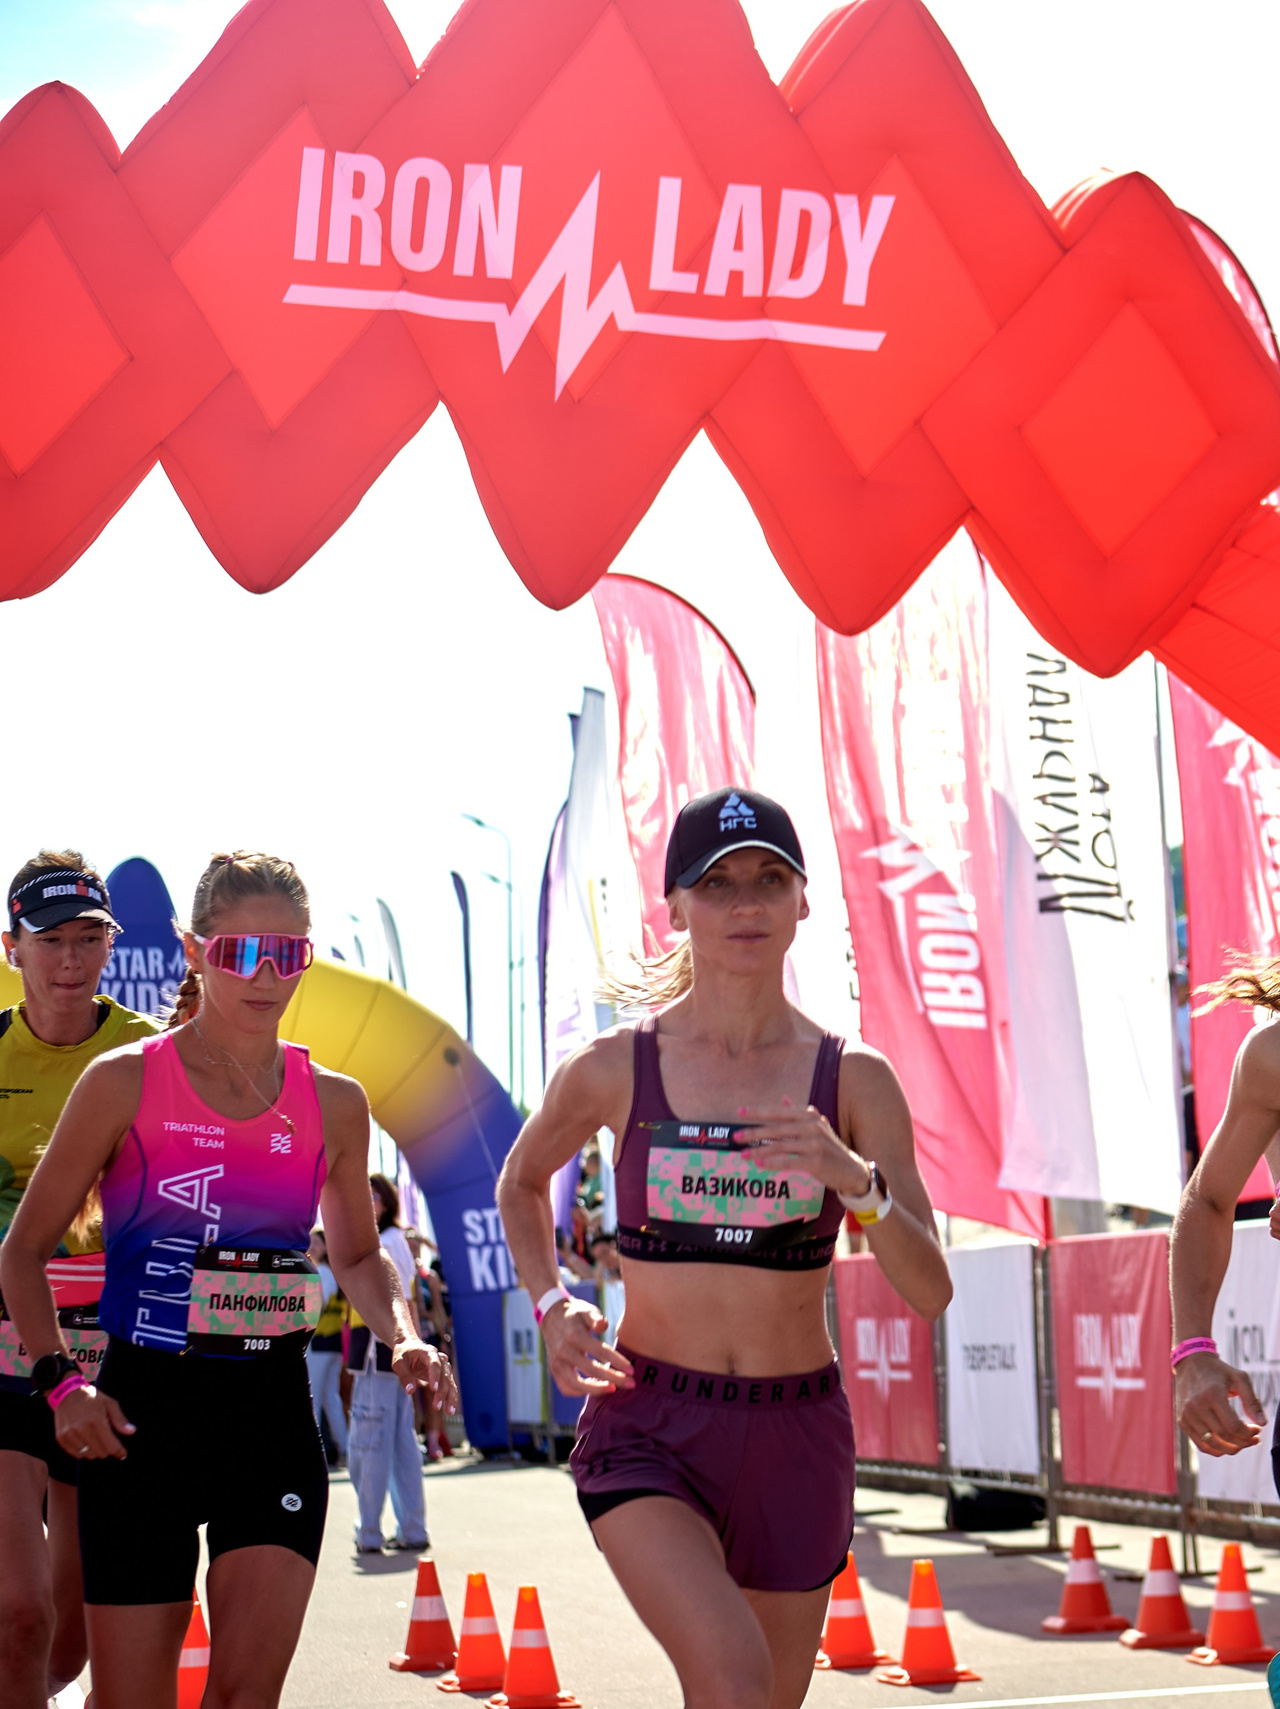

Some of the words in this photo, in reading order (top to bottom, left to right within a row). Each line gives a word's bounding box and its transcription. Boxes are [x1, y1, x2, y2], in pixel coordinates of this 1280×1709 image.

[294, 147, 522, 280] IRON
[649, 176, 896, 307] LADY
[719, 817, 757, 832] НГС
[103, 947, 165, 979] STAR
[163, 1122, 225, 1135] TRIATHLON
[679, 1126, 700, 1137] IRON
[708, 1127, 730, 1139] LADY
[193, 1138, 225, 1149] TEAM
[681, 1175, 790, 1199] ВАЗИКОВА
[463, 1208, 508, 1244] ST
[715, 1228, 753, 1243] 7007
[219, 1251, 236, 1260] IRON
[242, 1252, 260, 1261] LADY
[209, 1293, 306, 1312] ПАНФИЛОВА
[243, 1339, 271, 1350] 7003
[671, 1372, 784, 1404] UNDER
